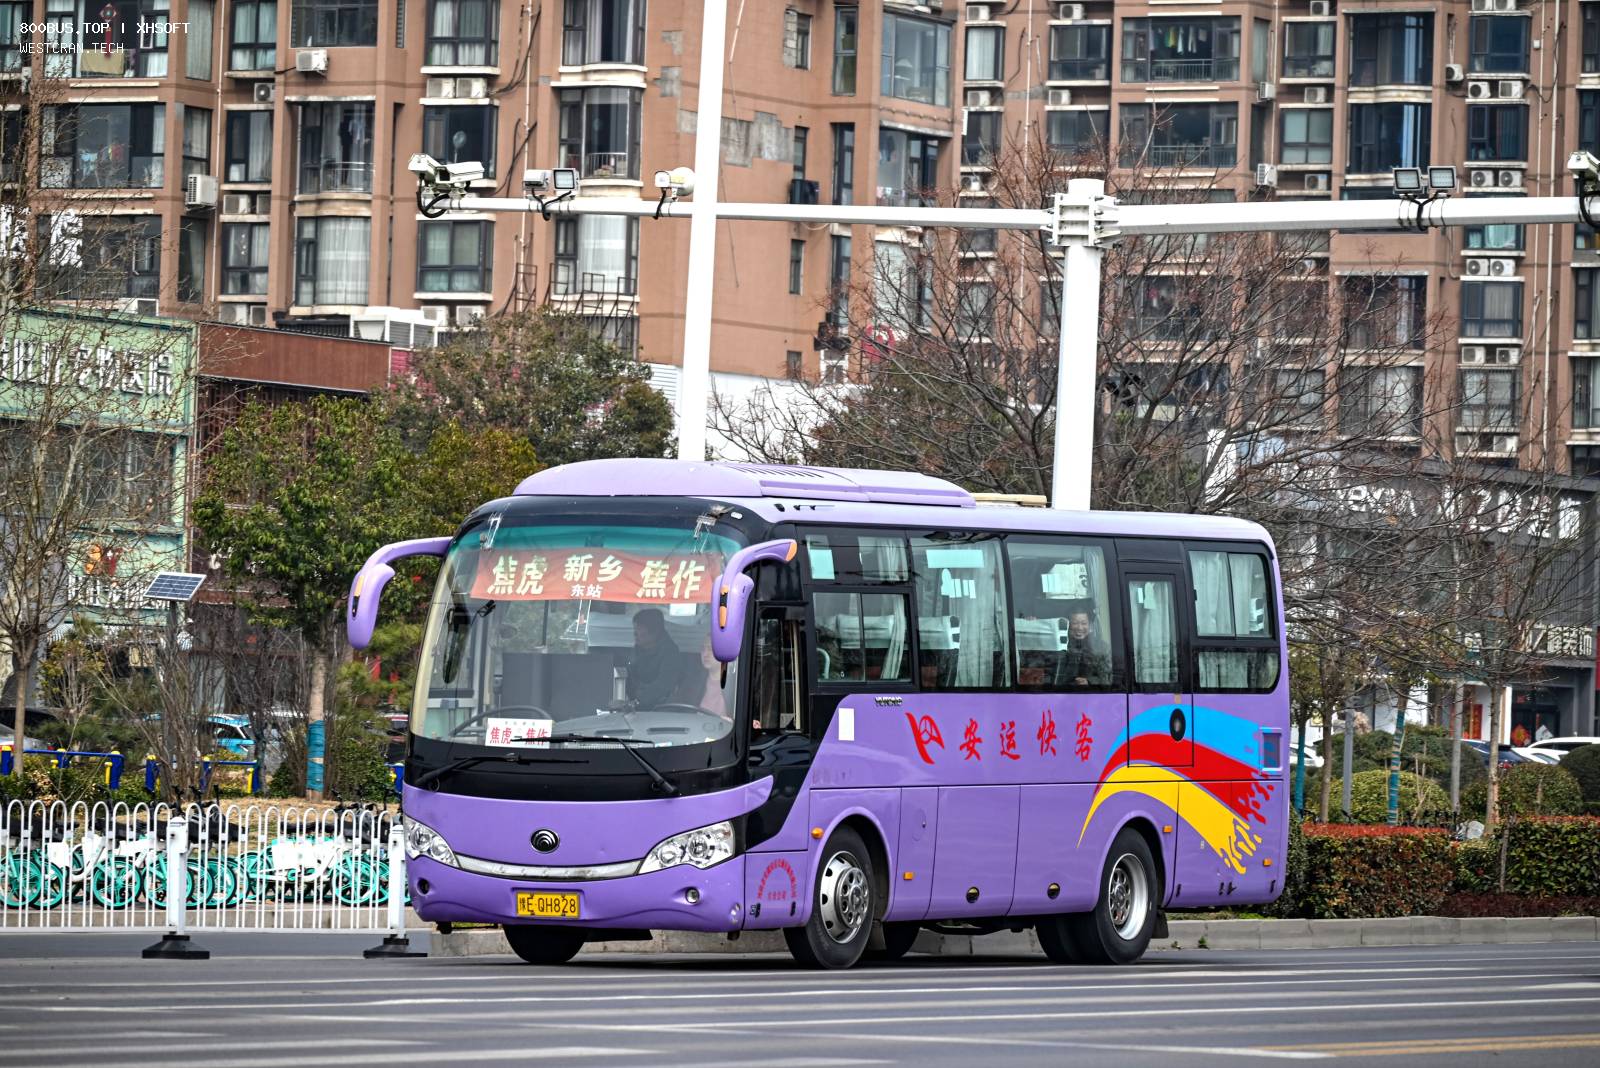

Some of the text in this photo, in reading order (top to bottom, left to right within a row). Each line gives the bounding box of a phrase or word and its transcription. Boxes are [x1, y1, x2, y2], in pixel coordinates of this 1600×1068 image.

[486, 553, 705, 600] 焦虎 新乡 焦作
[570, 584, 604, 600] 东站
